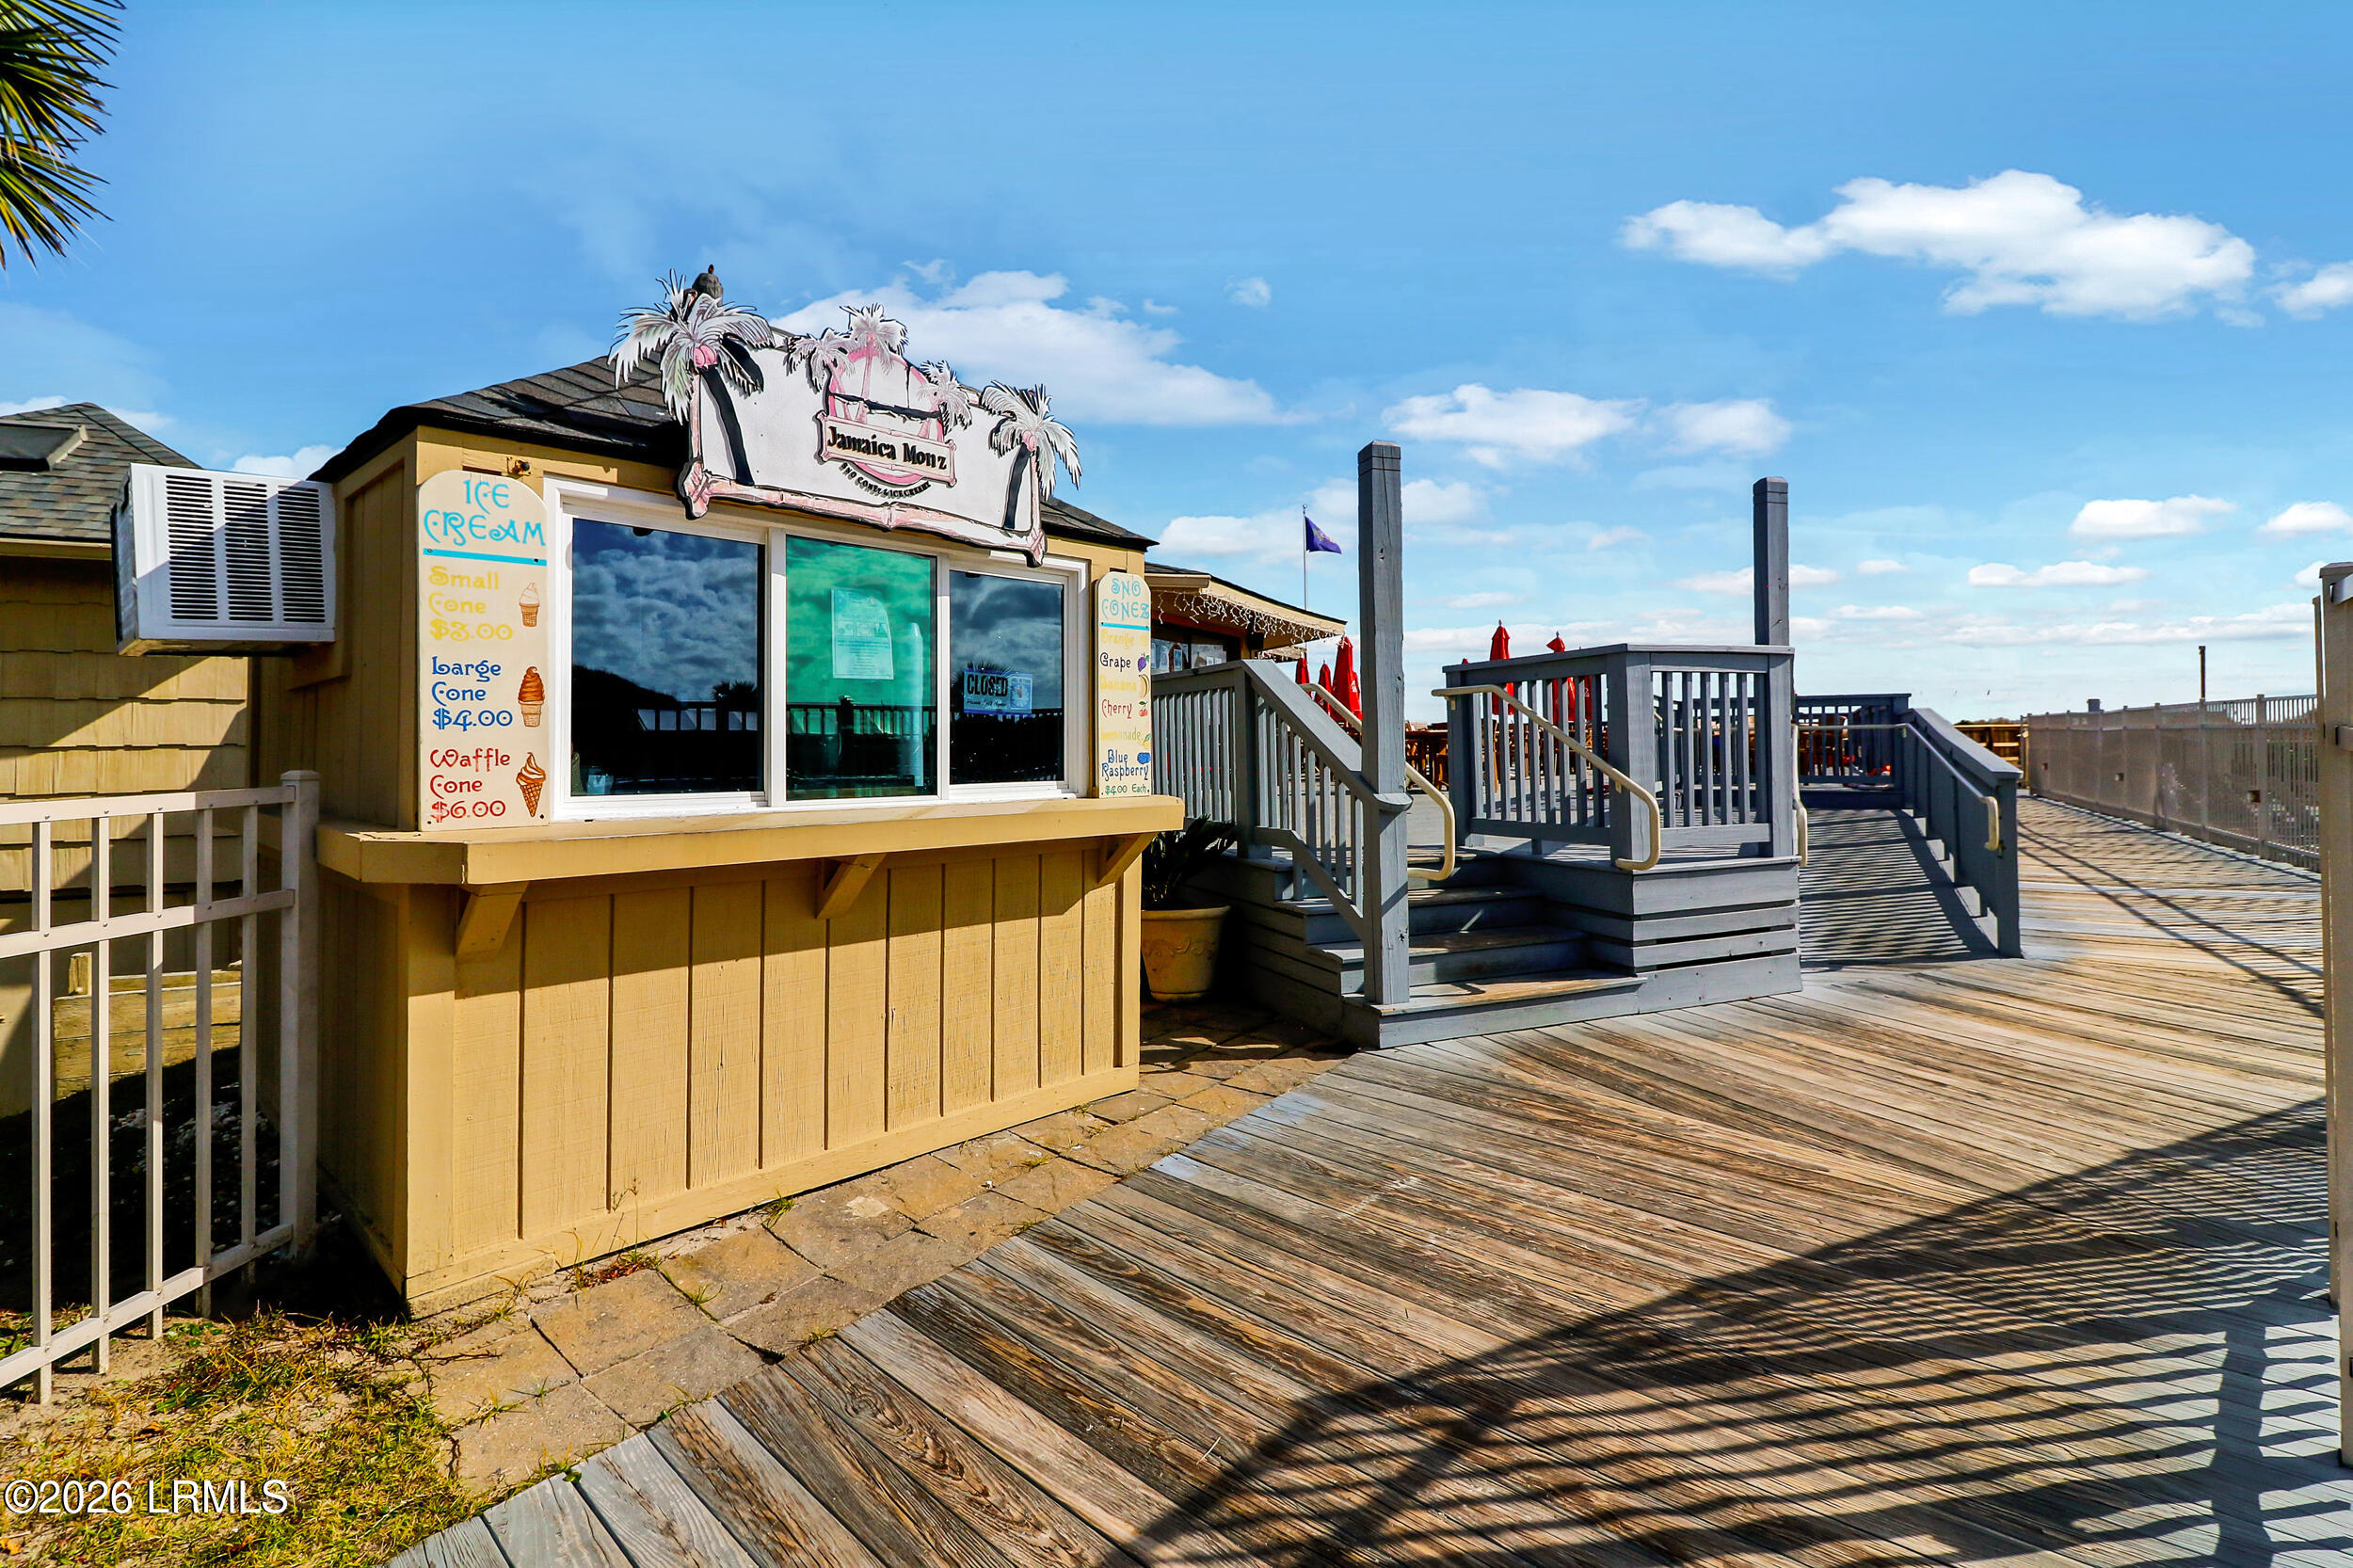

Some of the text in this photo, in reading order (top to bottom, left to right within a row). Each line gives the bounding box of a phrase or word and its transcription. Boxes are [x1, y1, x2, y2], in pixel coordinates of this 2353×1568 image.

[827, 425, 947, 470] Jamaica Monz
[840, 462, 857, 478] SNO
[889, 489, 904, 498] ICE
[463, 479, 509, 514] ICE
[424, 509, 546, 546] CREAM
[428, 565, 499, 590] Small
[1111, 577, 1142, 600] SNO
[428, 592, 487, 617] Cone
[1101, 598, 1150, 621] CONEZ
[429, 618, 514, 642] $3.00
[431, 656, 502, 682] Large
[1099, 651, 1132, 672] Grape
[431, 680, 487, 707] Cone
[967, 674, 1008, 696] CLOSED
[432, 708, 513, 731] $4.00
[1101, 698, 1132, 719] Cherry
[429, 747, 511, 773] Waffle
[1107, 748, 1128, 763] Blue
[1101, 761, 1149, 782] Raspberry
[429, 775, 483, 800] Cone
[1131, 783, 1147, 793] Each
[430, 800, 506, 824] $6.00
